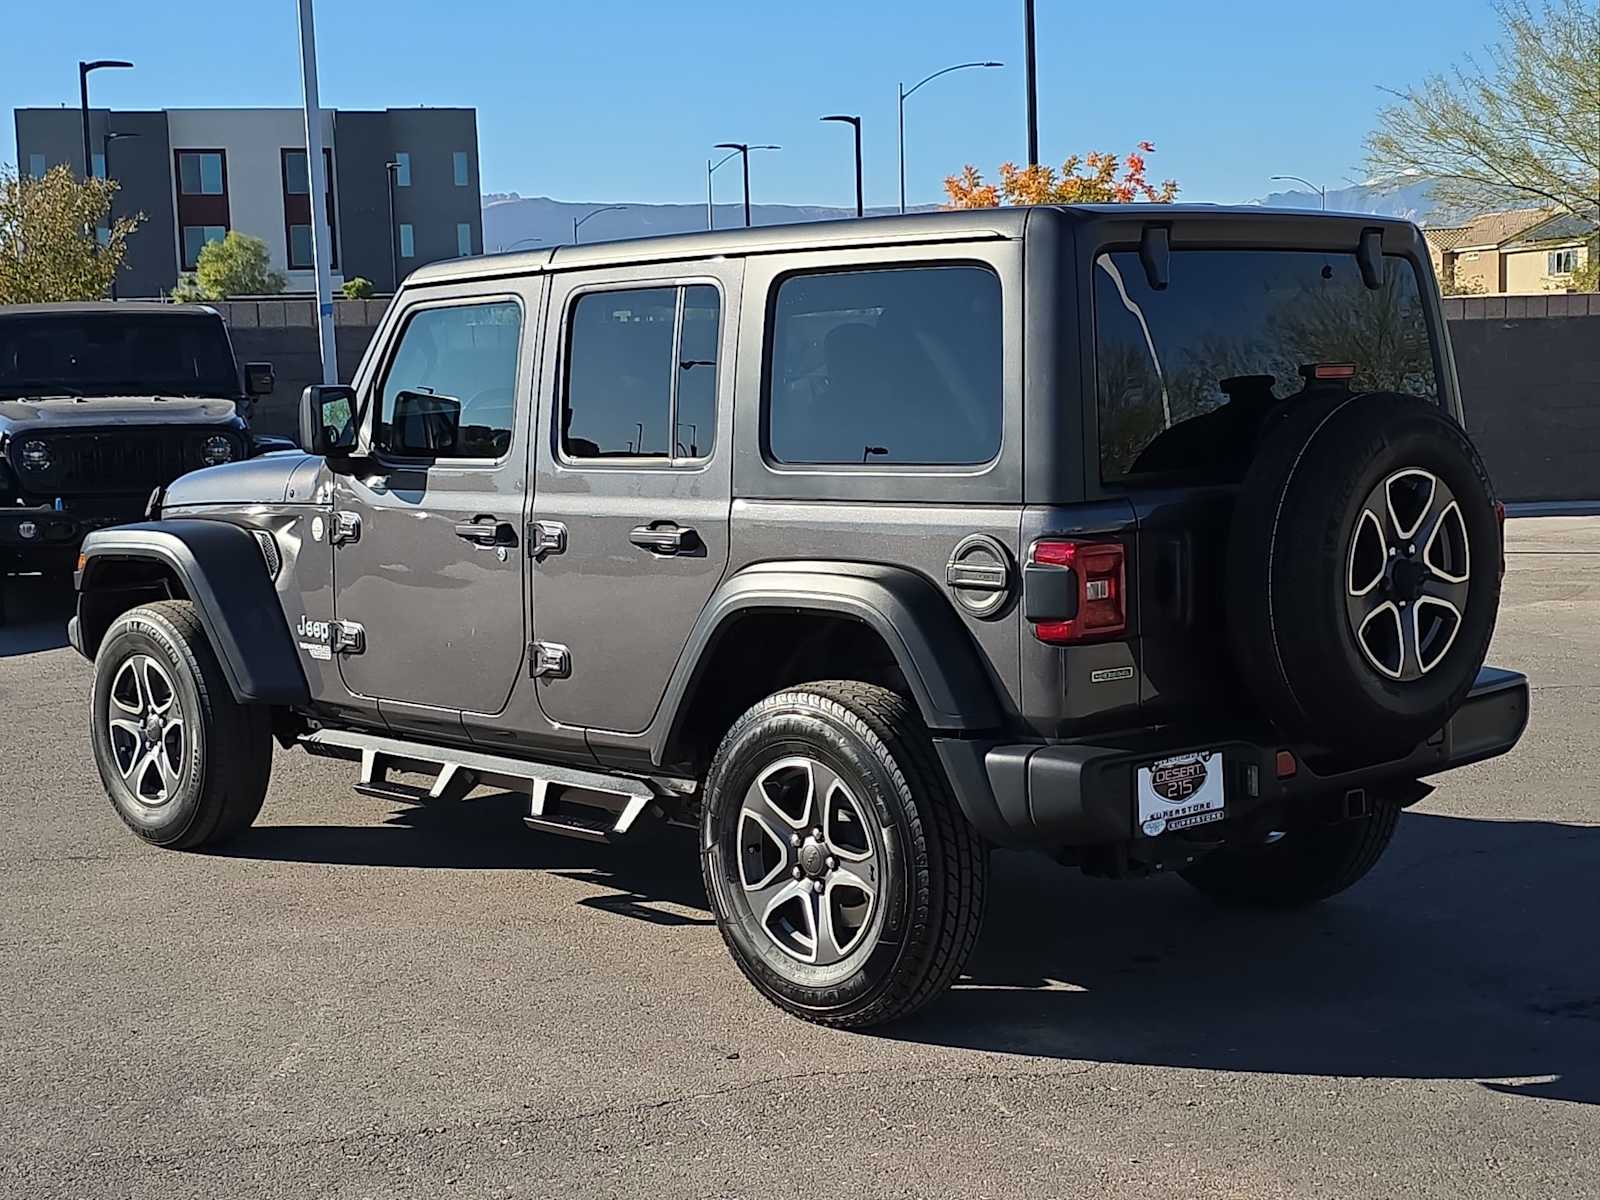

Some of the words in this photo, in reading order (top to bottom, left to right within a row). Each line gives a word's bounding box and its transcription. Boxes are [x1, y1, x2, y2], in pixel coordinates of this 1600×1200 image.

[297, 615, 329, 643] Jeep
[139, 621, 179, 664] MICHELIN
[1156, 763, 1202, 782] DESERT
[1167, 779, 1193, 798] 215
[1150, 802, 1211, 820] SUPERSTORE
